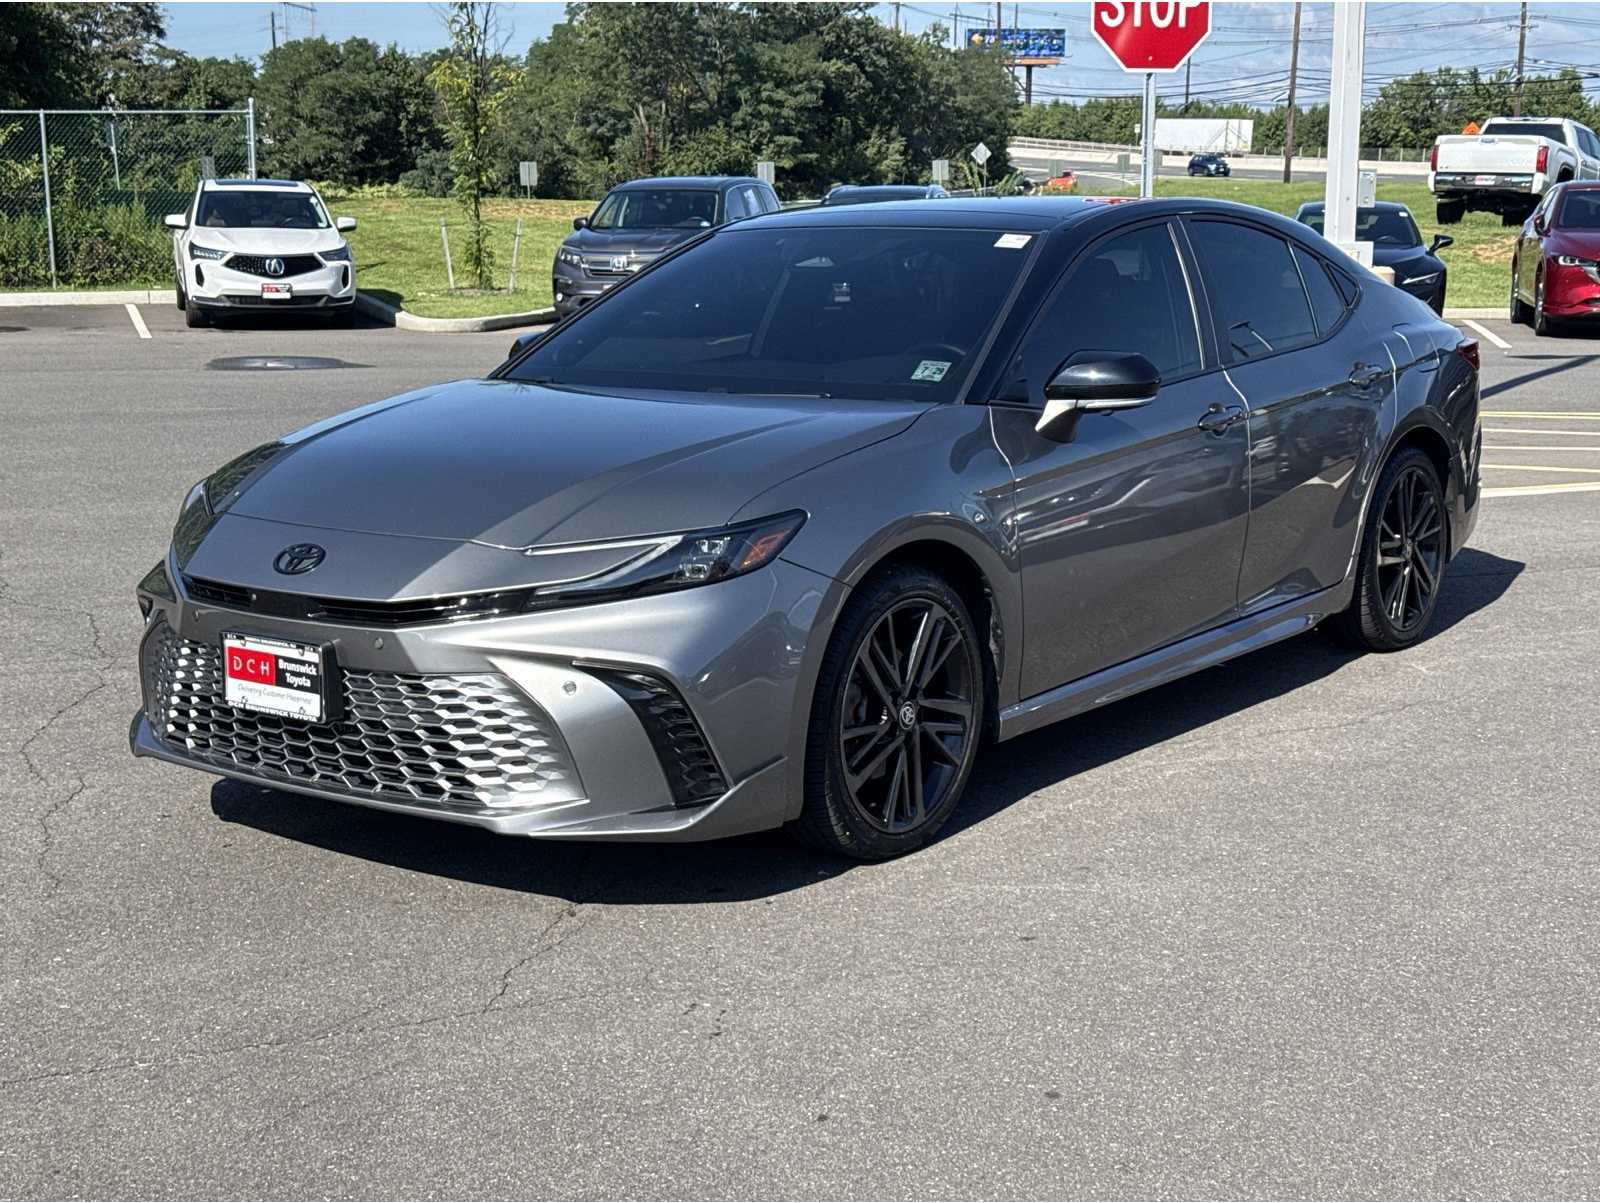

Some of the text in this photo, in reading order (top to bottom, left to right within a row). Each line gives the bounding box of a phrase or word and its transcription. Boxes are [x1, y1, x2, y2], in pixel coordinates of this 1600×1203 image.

[1101, 2, 1201, 28] STOP
[233, 656, 270, 676] DCH
[278, 658, 317, 676] Brunswick
[285, 672, 311, 687] Toyota
[289, 711, 318, 722] TOYOTA
